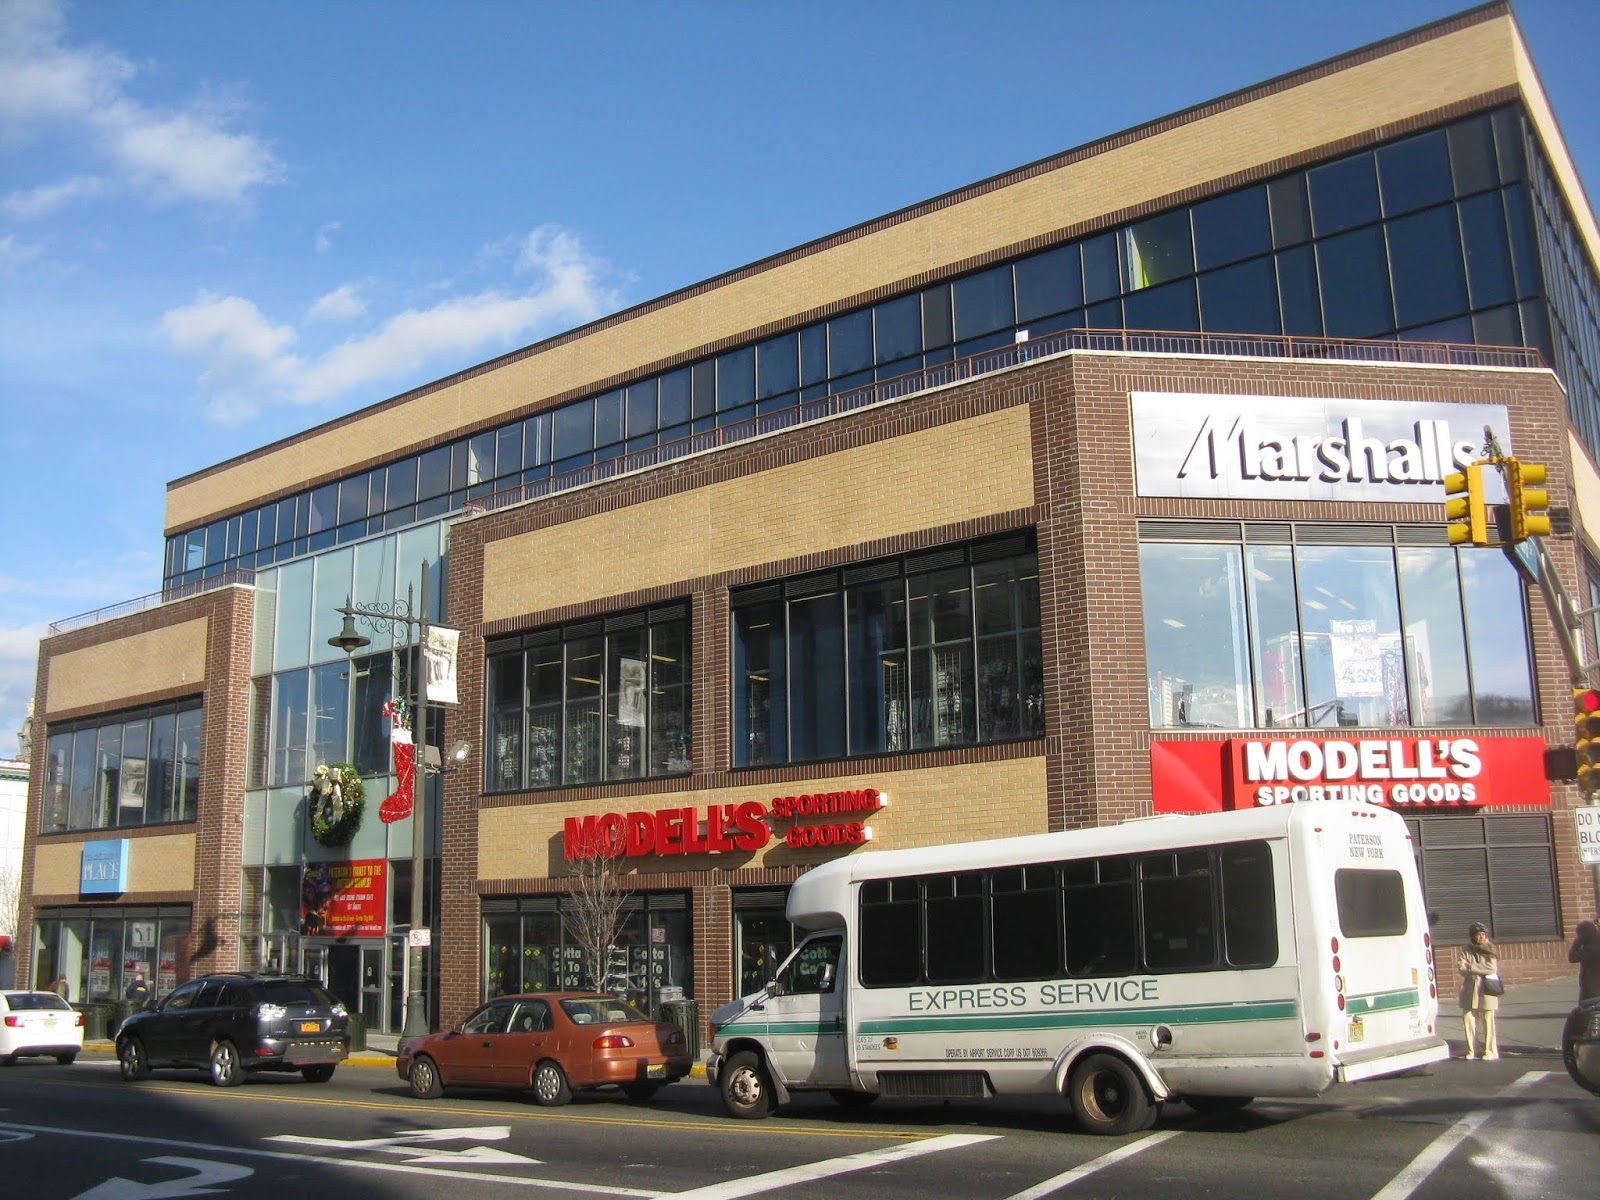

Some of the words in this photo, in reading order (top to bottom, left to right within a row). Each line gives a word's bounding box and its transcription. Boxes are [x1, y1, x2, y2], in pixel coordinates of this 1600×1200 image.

[1177, 415, 1478, 483] Marshalls
[1355, 622, 1376, 633] well
[1244, 739, 1482, 782] MODELL'S
[1257, 784, 1385, 806] SPORTING
[1391, 782, 1477, 803] GOODS
[563, 802, 771, 859] MODELL'S
[772, 788, 880, 818] SPORTING
[1577, 812, 1592, 826] DO
[786, 823, 865, 848] GOODS
[1348, 833, 1382, 846] PATERSON
[1349, 847, 1365, 858] NEW
[1366, 848, 1384, 859] YORK
[83, 861, 118, 881] PLACE
[552, 947, 581, 959] Gtta
[633, 947, 664, 960] Gota
[800, 946, 835, 960] Gott
[568, 961, 580, 973] To
[908, 986, 1027, 1011] EXPRESS
[1040, 979, 1159, 1005] SERVICE
[986, 1048, 1003, 1058] SERVICE
